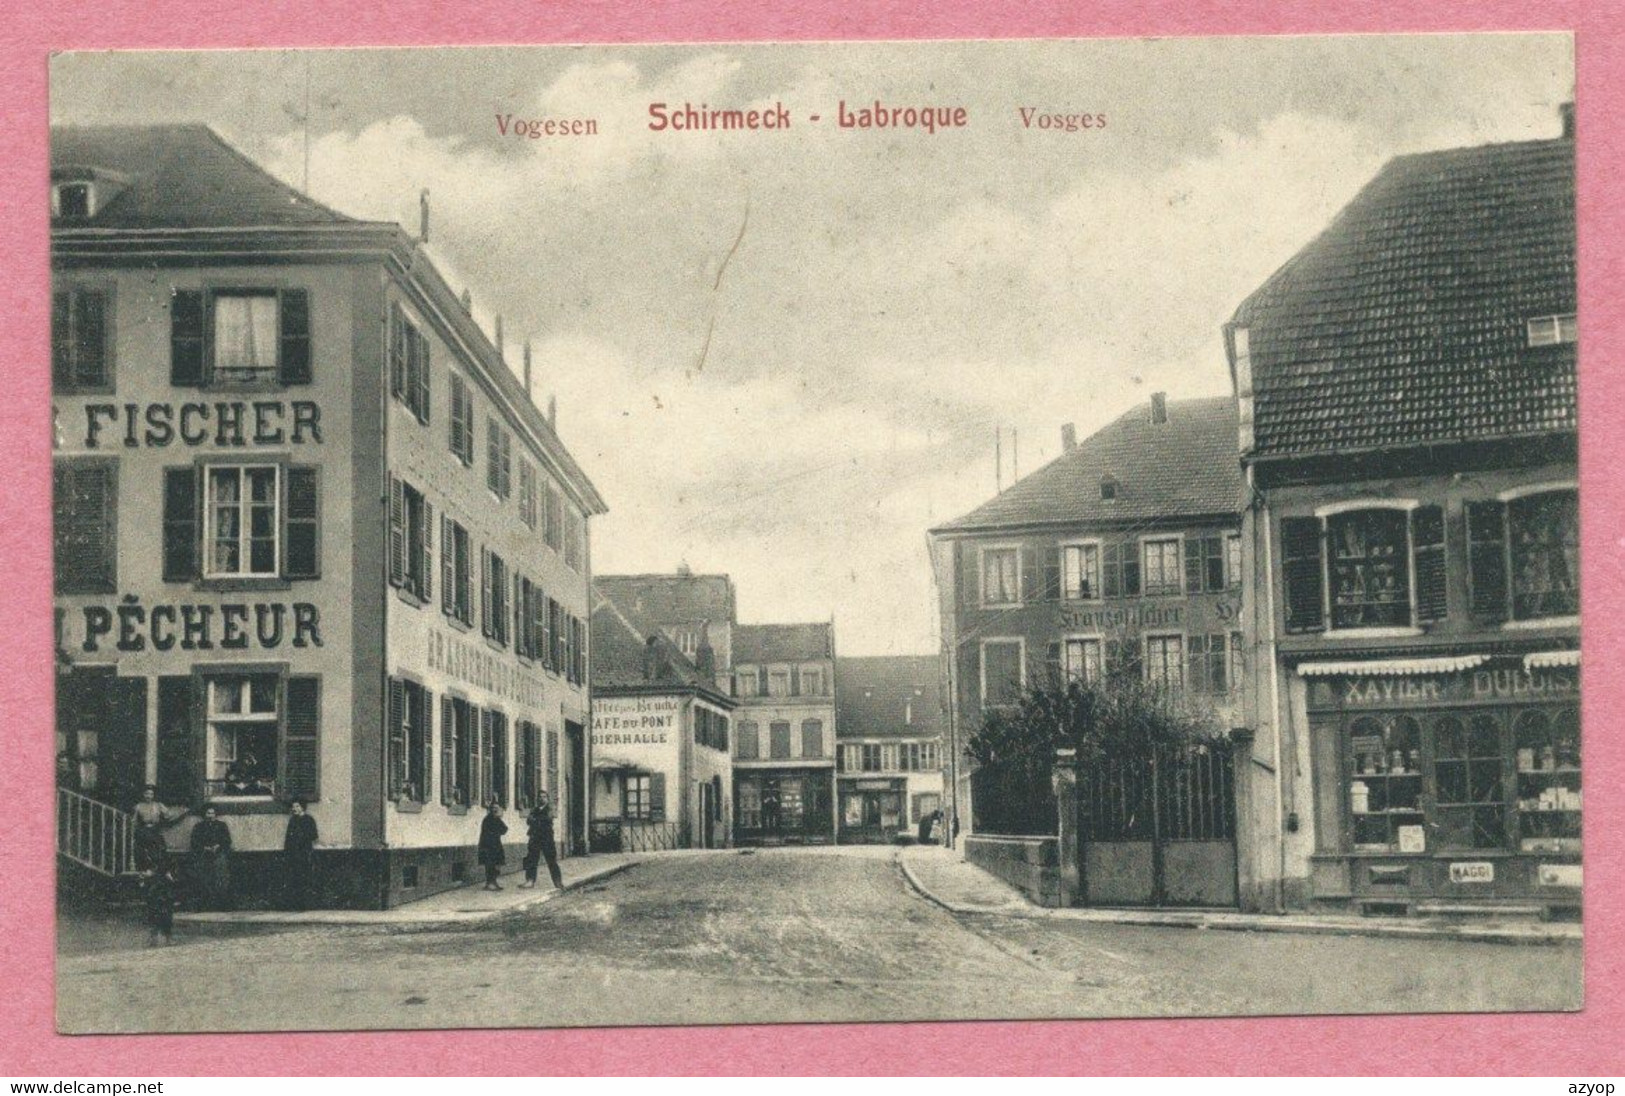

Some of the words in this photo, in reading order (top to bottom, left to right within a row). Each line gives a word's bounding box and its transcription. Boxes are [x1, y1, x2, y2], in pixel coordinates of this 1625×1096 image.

[84, 401, 323, 448] FISCHER
[83, 593, 323, 652] PÊCHEUR
[641, 715, 673, 728] PONT
